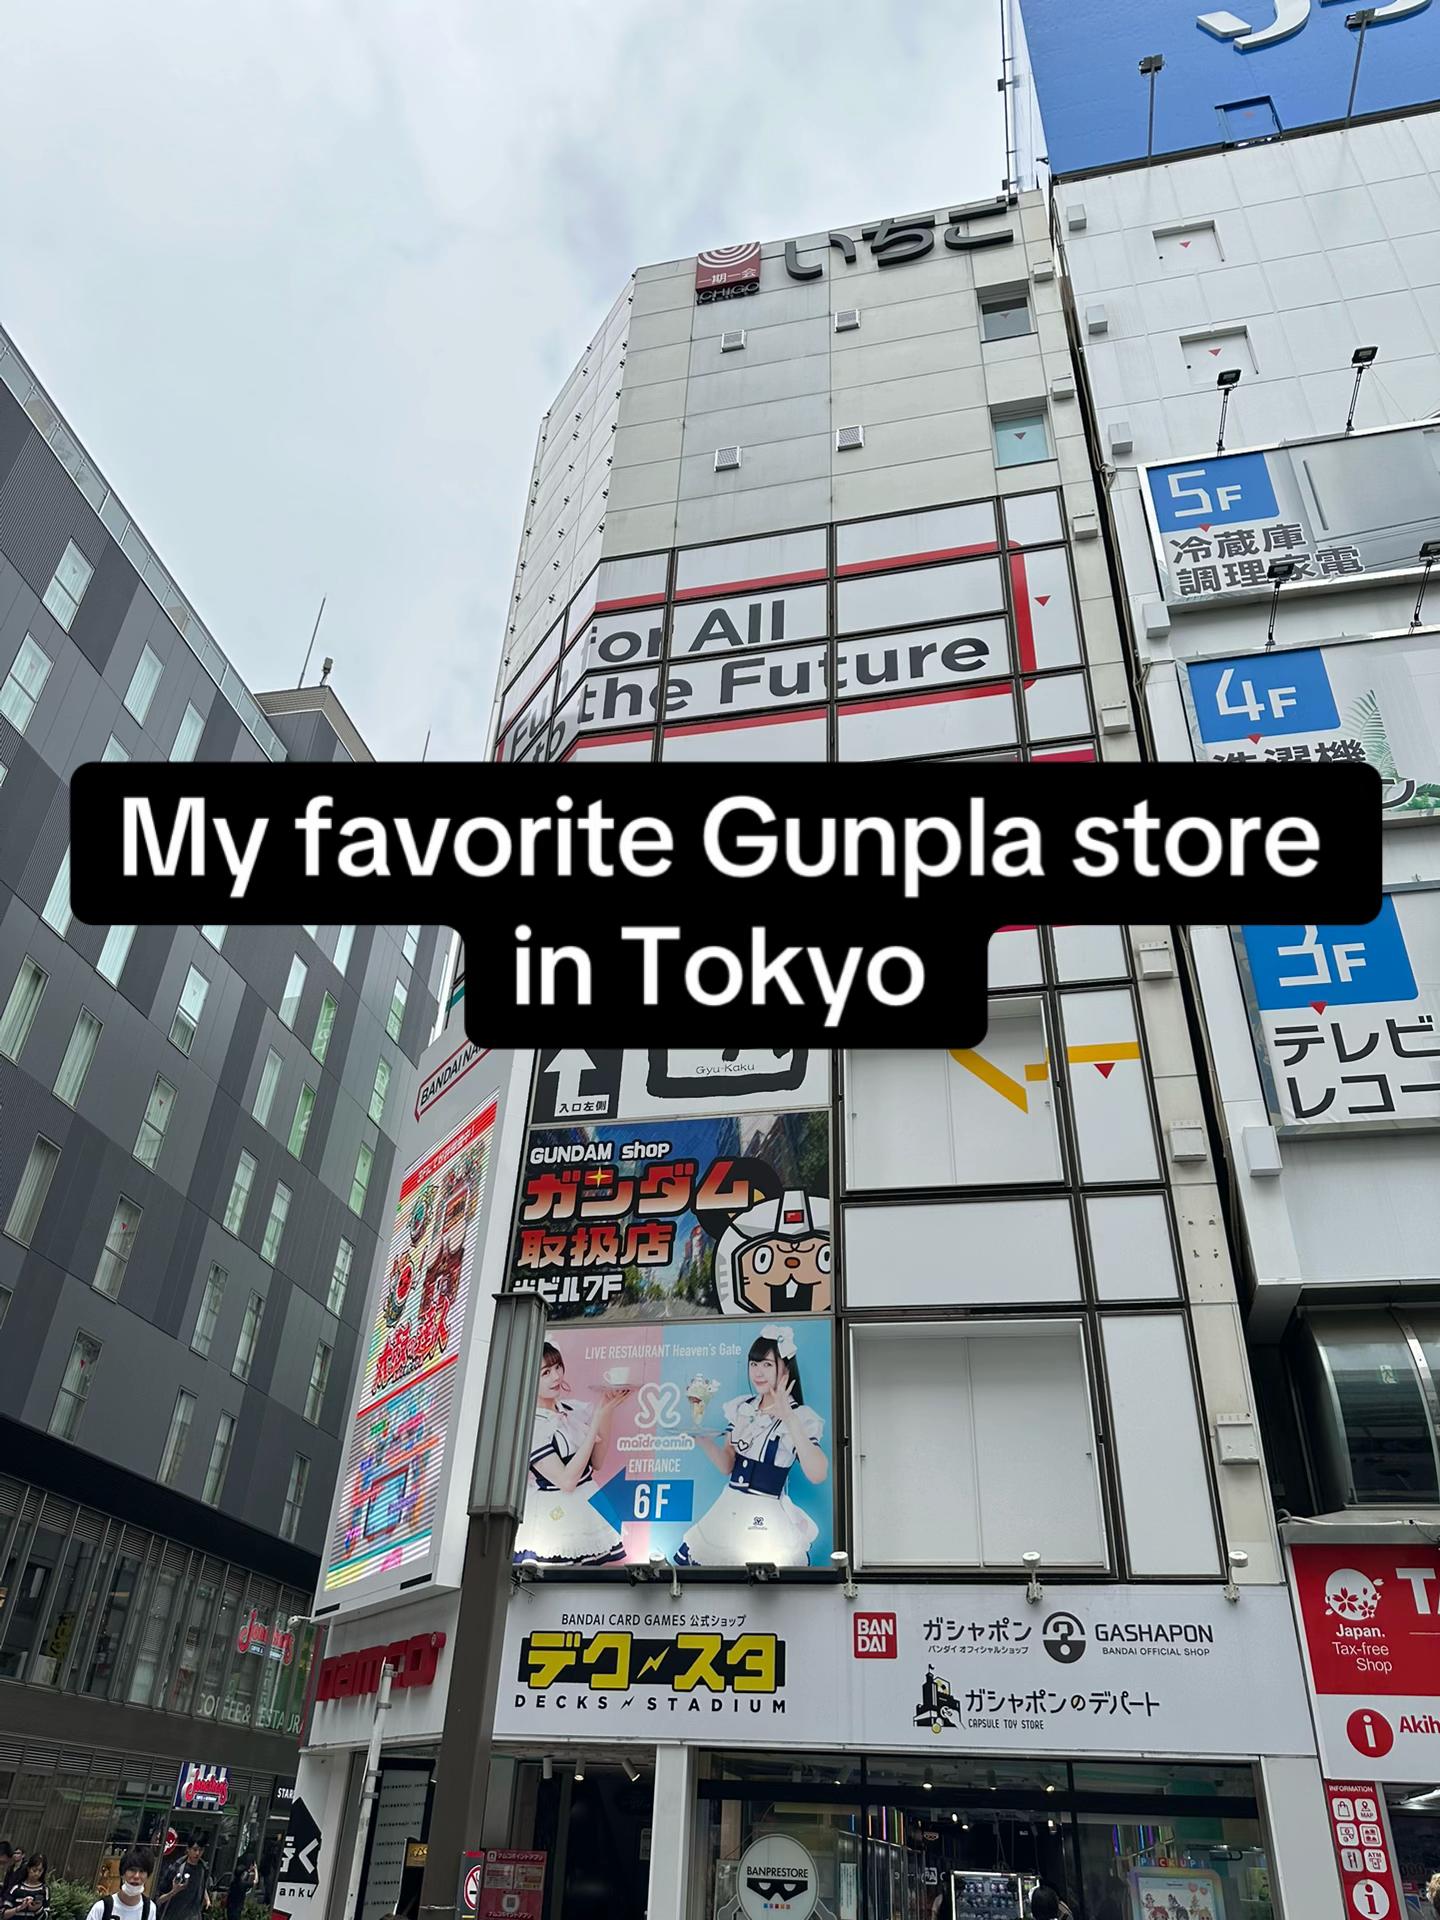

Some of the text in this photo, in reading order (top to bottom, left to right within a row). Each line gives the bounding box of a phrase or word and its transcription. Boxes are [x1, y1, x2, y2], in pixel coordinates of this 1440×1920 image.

[784, 193, 1018, 281] いちご
[1167, 469, 1242, 519] 5F
[1169, 523, 1307, 564] 冷蔵庫
[688, 599, 785, 652] All
[578, 636, 990, 725] the Future
[1215, 667, 1297, 721] 4F
[1277, 925, 1367, 987] 3F
[1273, 1014, 1440, 1067] テレビ
[695, 1062, 755, 1076] Gyu-Kaku
[419, 1057, 463, 1107] BANDAI
[558, 1100, 607, 1114] 入口左側
[530, 1140, 671, 1165] GUNDAM shop
[522, 1159, 750, 1220] ガンダム
[517, 1222, 673, 1268] 取扱店
[585, 1342, 742, 1361] LIVE RESTAURANT Heaven's Gate
[618, 1433, 695, 1451] maidreamin
[628, 1458, 681, 1473] ENTRANCE
[633, 1483, 671, 1519] 6F
[561, 1613, 747, 1628] BANDAI CARD GAMES 公式ショップ
[857, 1618, 894, 1635] BAN
[922, 1616, 1033, 1642] ガシャポン
[1095, 1623, 1214, 1643] GASHAPON
[1336, 1623, 1386, 1640] Japan.
[857, 1635, 887, 1653] DAI
[1102, 1647, 1211, 1657] BANDAI OFFICIAL SHOP
[1332, 1641, 1390, 1656] Tax-free
[1356, 1657, 1393, 1674] Shop
[514, 1694, 787, 1714] DECKS STADIUM
[965, 1688, 1160, 1717] ガシャポンのデパート
[968, 1718, 1045, 1730] CAPSULE TOY STORE
[1328, 1785, 1374, 1793] INFORMATION
[746, 1866, 809, 1879] BANPRESTORE
